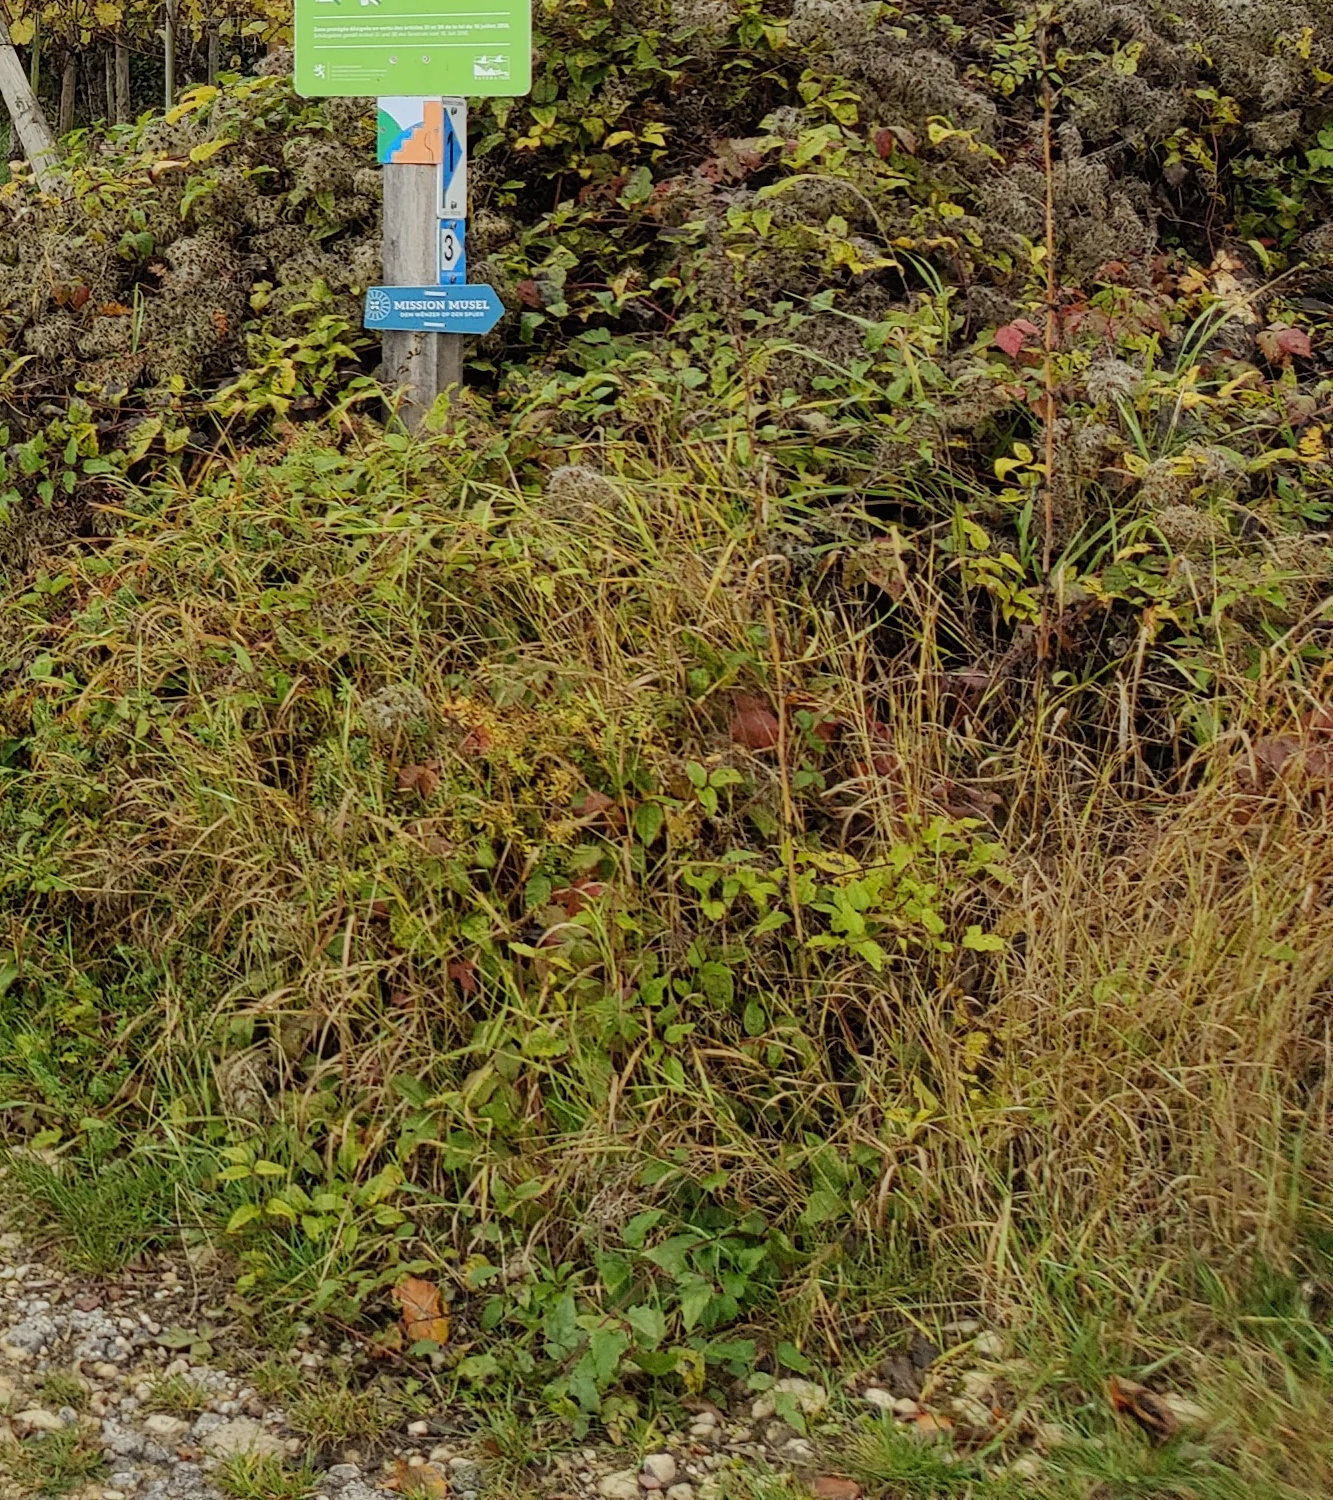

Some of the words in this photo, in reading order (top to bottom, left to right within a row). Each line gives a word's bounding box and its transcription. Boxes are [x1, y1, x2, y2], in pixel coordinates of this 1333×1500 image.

[446, 130, 454, 173] 1
[444, 234, 454, 262] 3
[394, 300, 446, 310] MISSION
[448, 300, 490, 310] MUSEL
